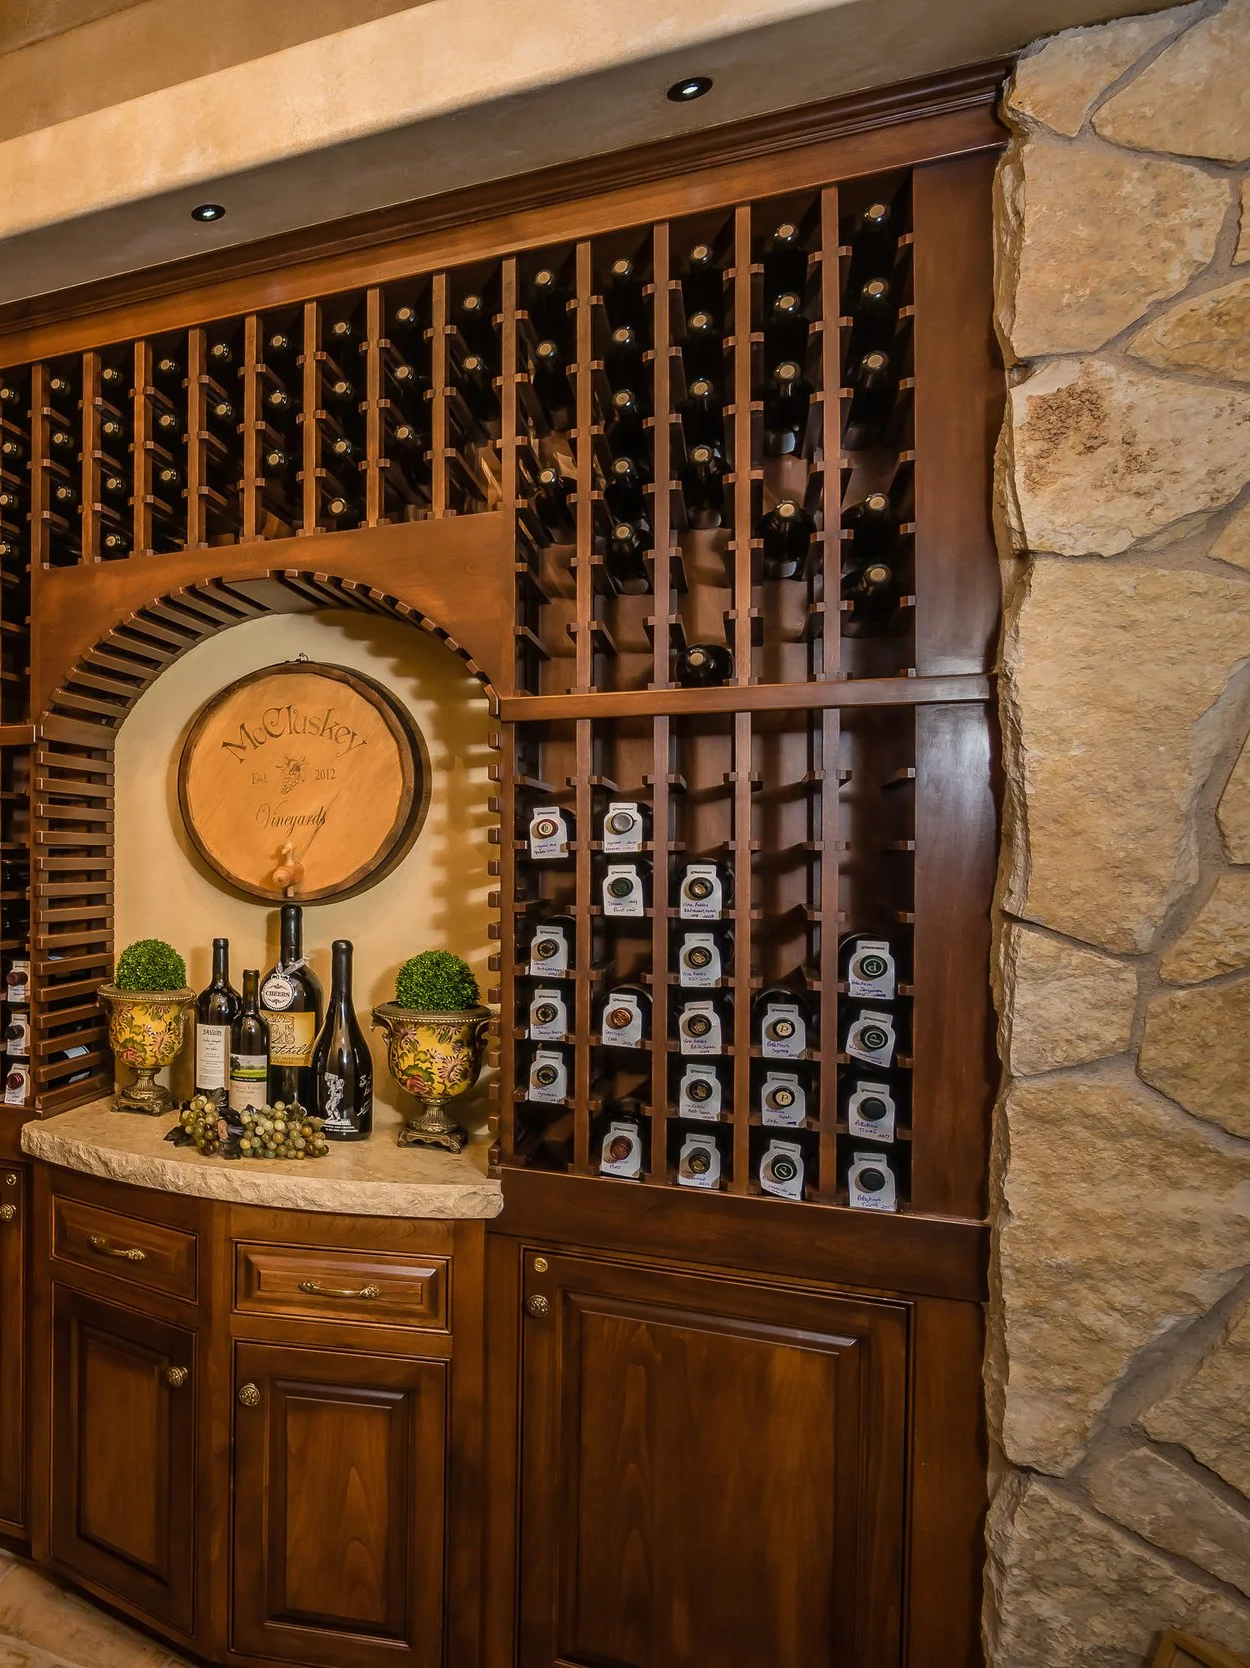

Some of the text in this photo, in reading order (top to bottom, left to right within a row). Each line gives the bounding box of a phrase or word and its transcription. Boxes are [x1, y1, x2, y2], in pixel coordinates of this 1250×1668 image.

[221, 704, 368, 764] McCluskey
[251, 768, 337, 785] Est. 2012
[255, 800, 327, 837] Vineyards
[265, 990, 290, 998] CHEERS
[780, 1025, 788, 1033] P
[781, 1094, 788, 1104] P
[780, 1166, 788, 1176] P
